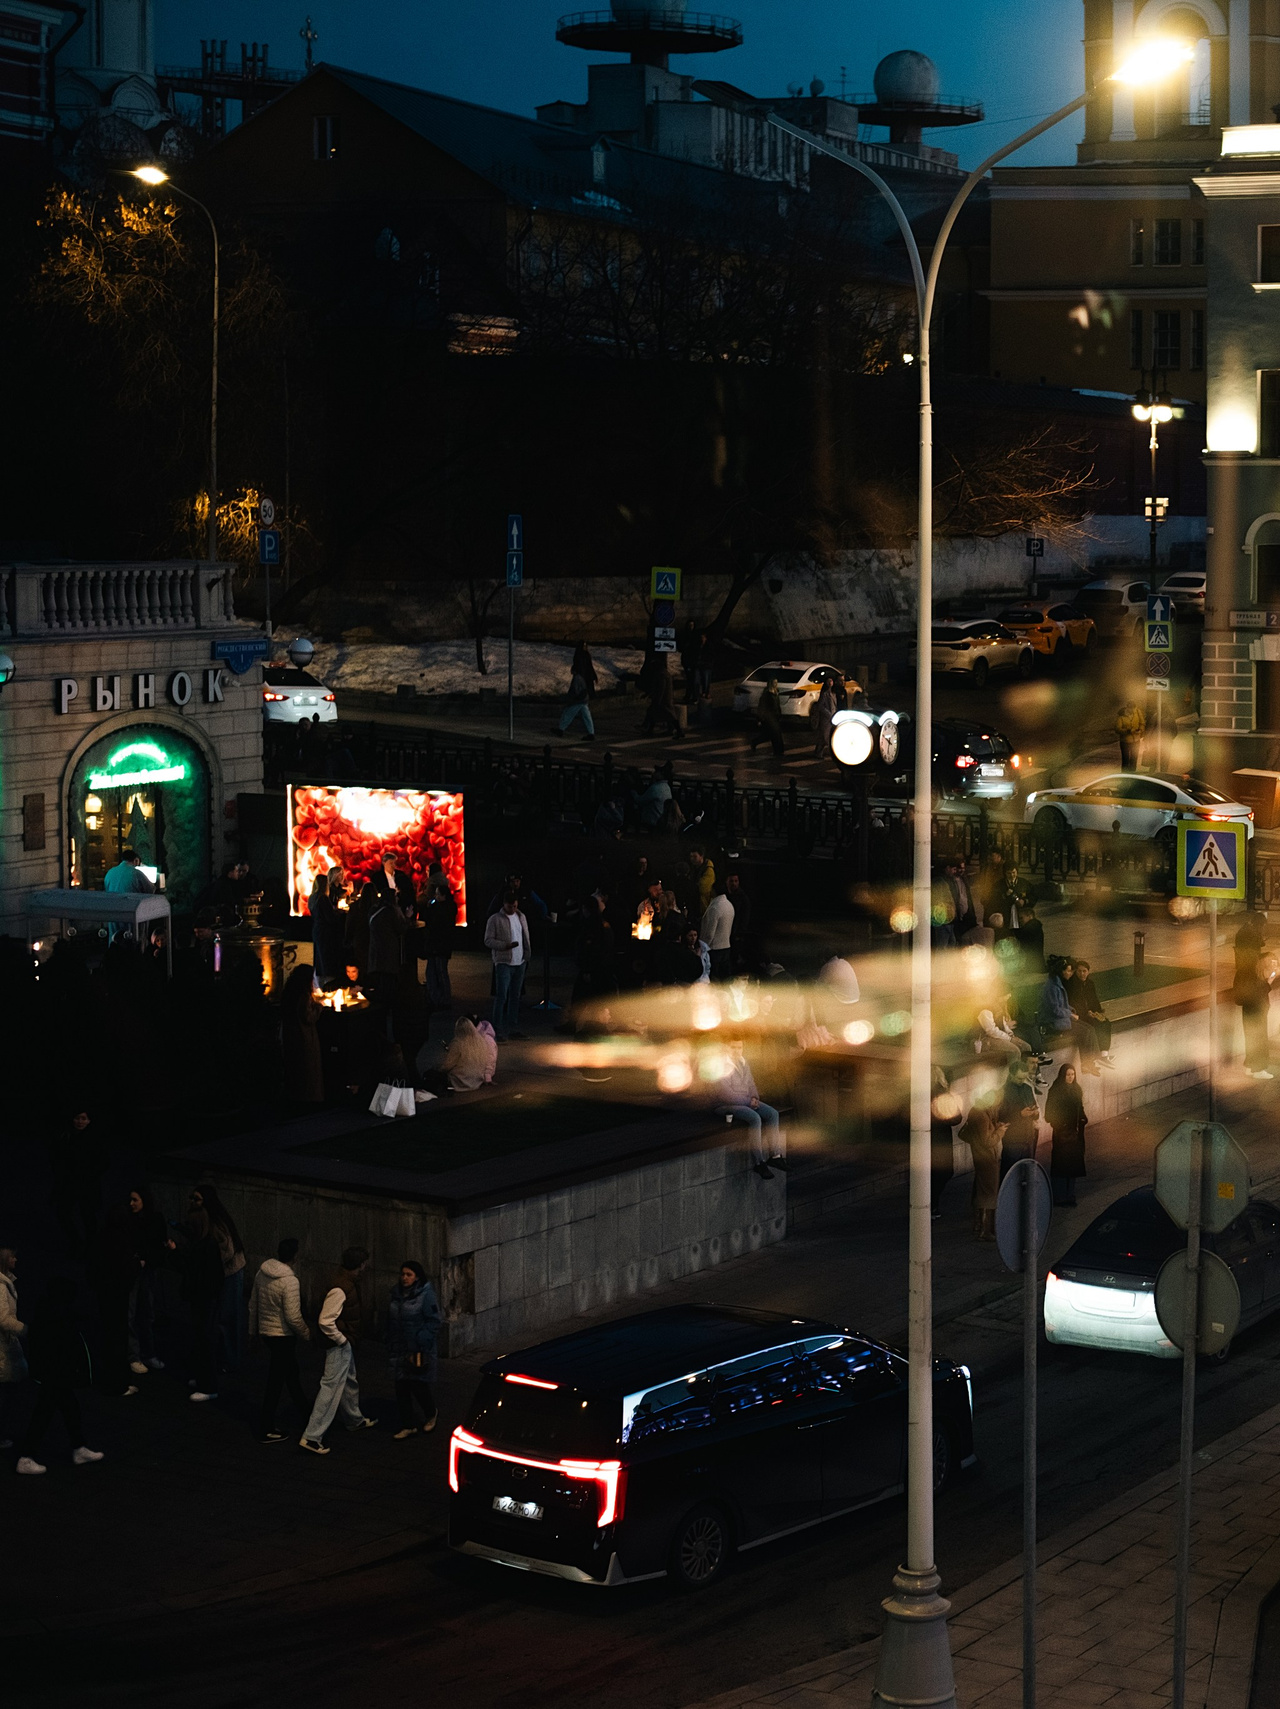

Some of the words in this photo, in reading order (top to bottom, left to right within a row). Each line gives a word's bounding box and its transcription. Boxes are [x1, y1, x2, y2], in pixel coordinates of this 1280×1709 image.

[262, 505, 273, 518] 50
[1270, 614, 1278, 625] 2
[59, 669, 224, 714] РЫНОК
